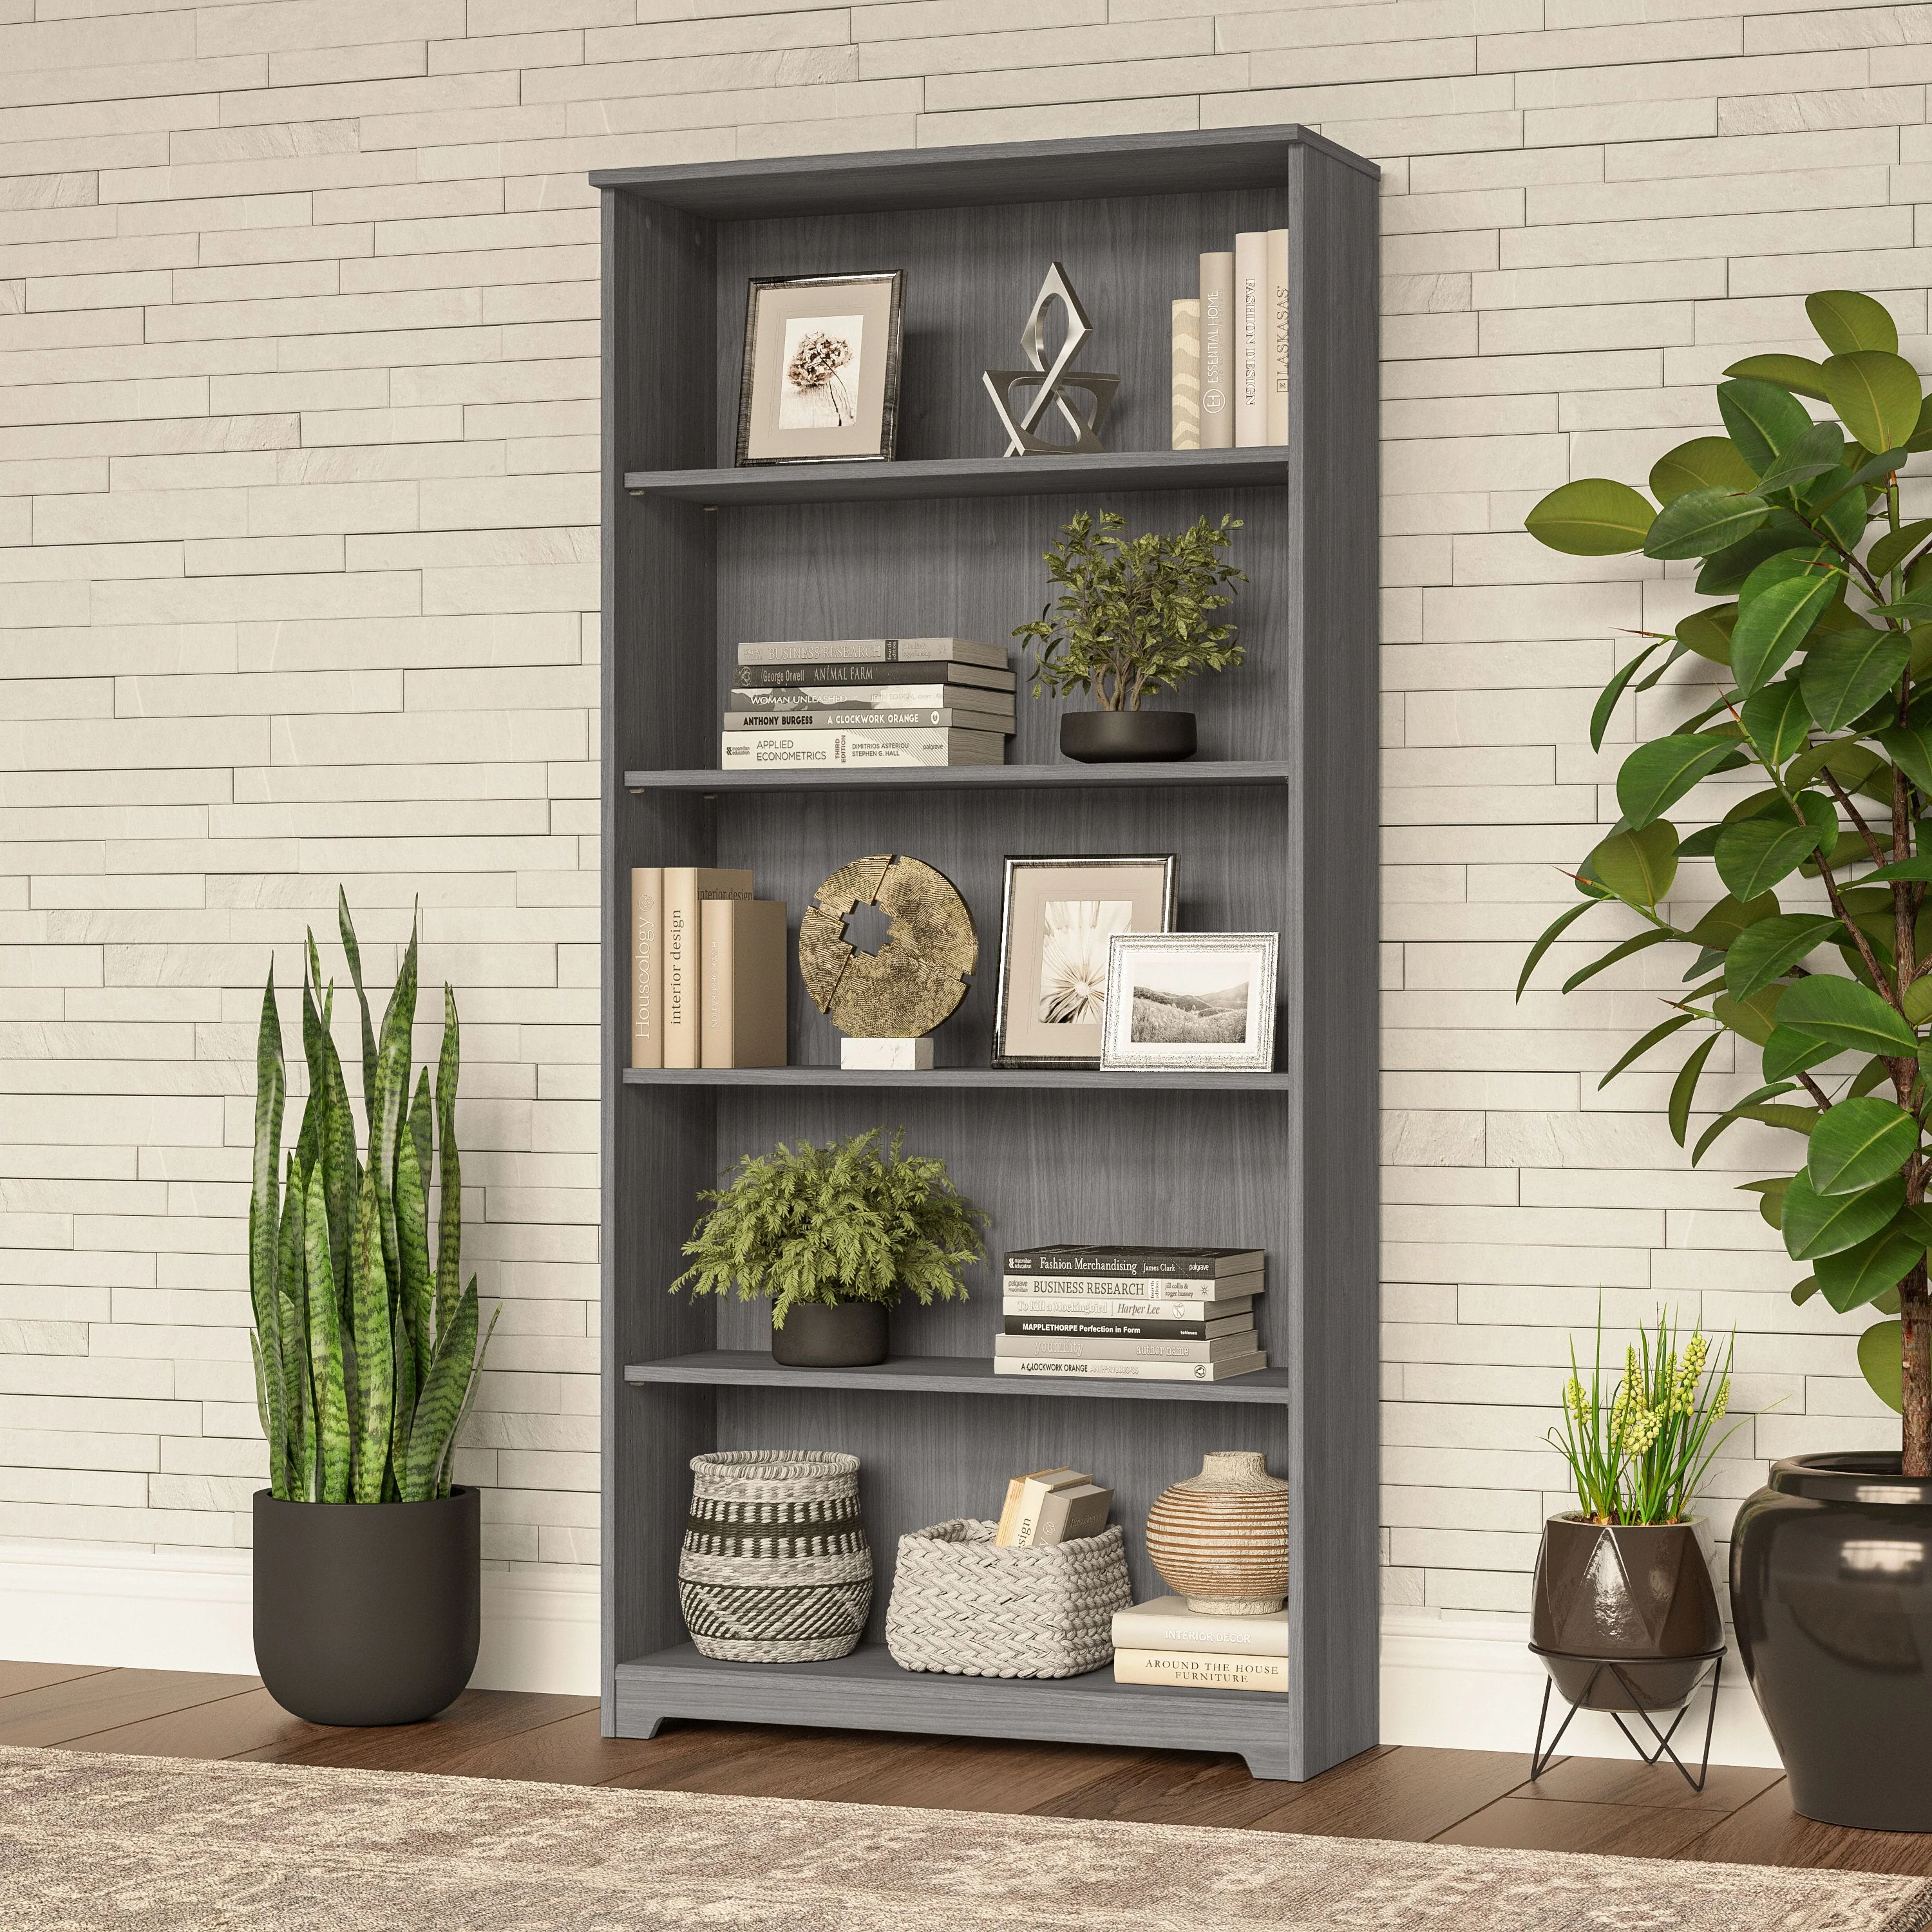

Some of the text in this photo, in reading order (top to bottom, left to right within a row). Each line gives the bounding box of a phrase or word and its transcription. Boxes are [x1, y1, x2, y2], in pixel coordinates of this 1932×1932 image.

[1207, 290, 1218, 383] ESSENTIAL HOME
[1245, 278, 1256, 405] FASHION DESIGN
[768, 645, 881, 660] BUSINESS RESEARCH
[763, 670, 784, 685] George
[786, 670, 804, 682] Orwell
[850, 667, 873, 680] FARM
[750, 696, 790, 705] WOMAN
[793, 695, 848, 704] UNLEASHED
[743, 714, 919, 726] ANTHONY BURGESS A CLOCKWORK ORANGE
[757, 740, 794, 750] APPLIED
[757, 751, 826, 761] ECONOMETRICS
[697, 887, 752, 900] interior design
[670, 909, 684, 1025] interior design
[635, 916, 654, 1040] Houseology
[1039, 1256, 1176, 1275] Fashion Merchandising James Clark
[1189, 1263, 1209, 1272] palgrave
[1033, 1281, 1144, 1295] BUSINESS RESEARCH
[1017, 1300, 1028, 1311] To
[1030, 1300, 1045, 1312] Kill
[1054, 1302, 1108, 1314] Mockingbird
[1117, 1303, 1146, 1316] Harper
[1147, 1304, 1160, 1314] Lee
[1022, 1323, 1078, 1332] MAPPLETHORPE
[1079, 1325, 1113, 1333] Perfection
[1035, 1340, 1083, 1357] youmility
[1136, 1344, 1189, 1356] author name
[1027, 1363, 1063, 1372] CLOCKWORK
[1063, 1364, 1088, 1372] ORANGE
[1165, 1629, 1251, 1643] INTERIOR DECOR
[1145, 1659, 1278, 1674] AROUND THE HOUSE
[1175, 1671, 1248, 1683] FURNITURE
